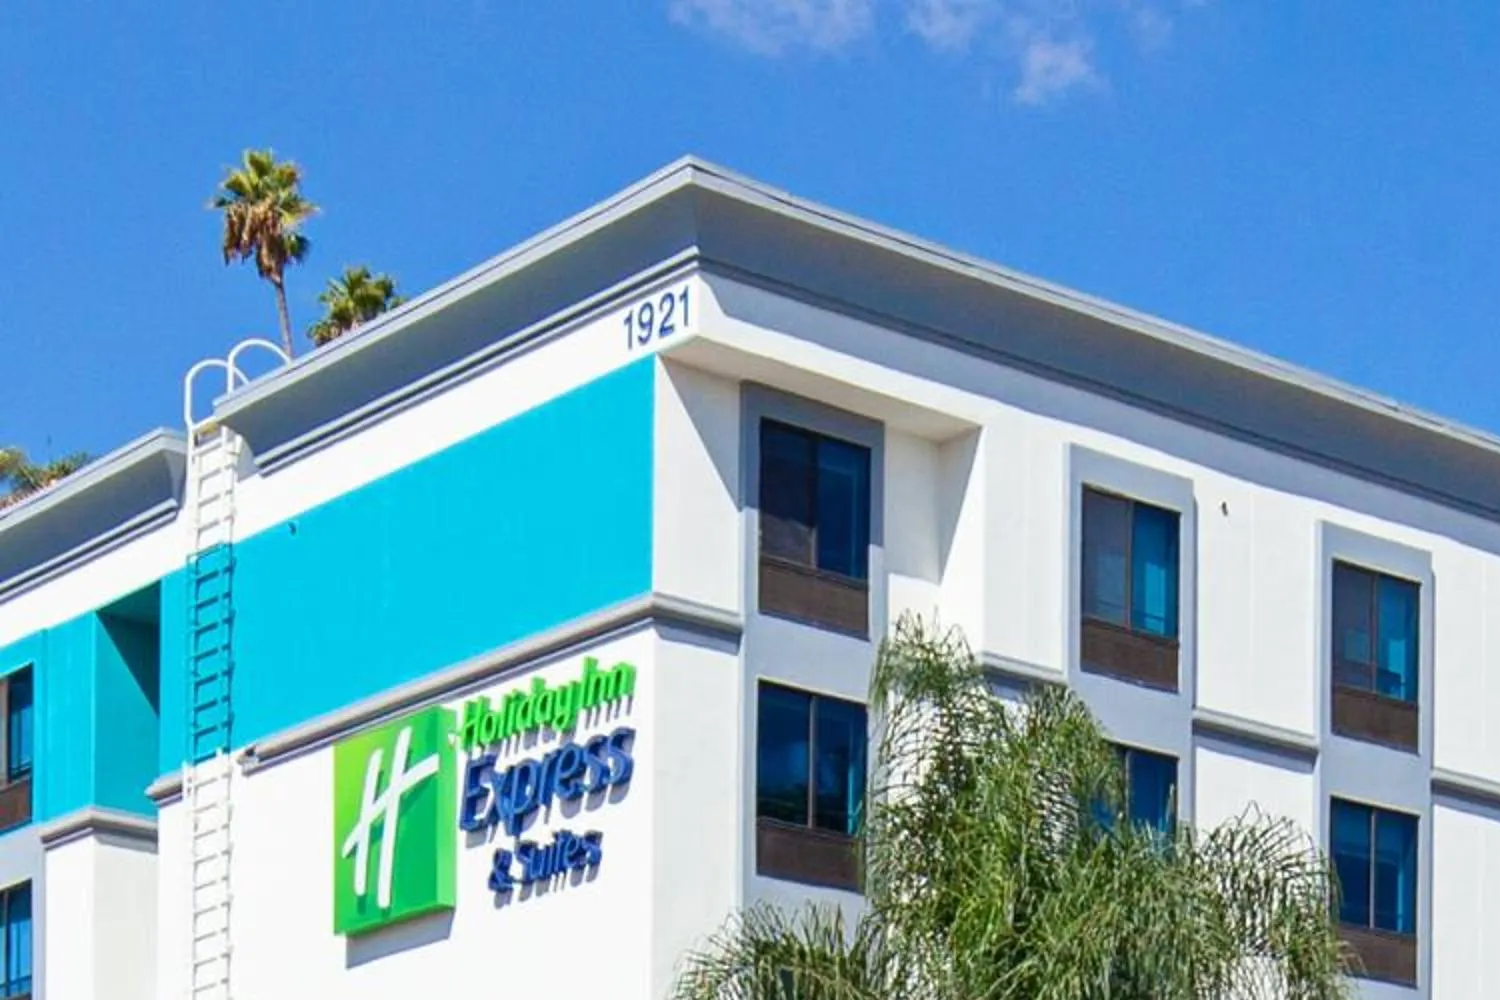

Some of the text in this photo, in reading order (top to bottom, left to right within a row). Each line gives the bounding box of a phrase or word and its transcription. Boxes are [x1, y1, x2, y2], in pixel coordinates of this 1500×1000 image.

[624, 285, 689, 350] 1921
[461, 657, 636, 751] Holiday Inn
[460, 727, 636, 836] Express
[488, 829, 603, 892] & Suites
